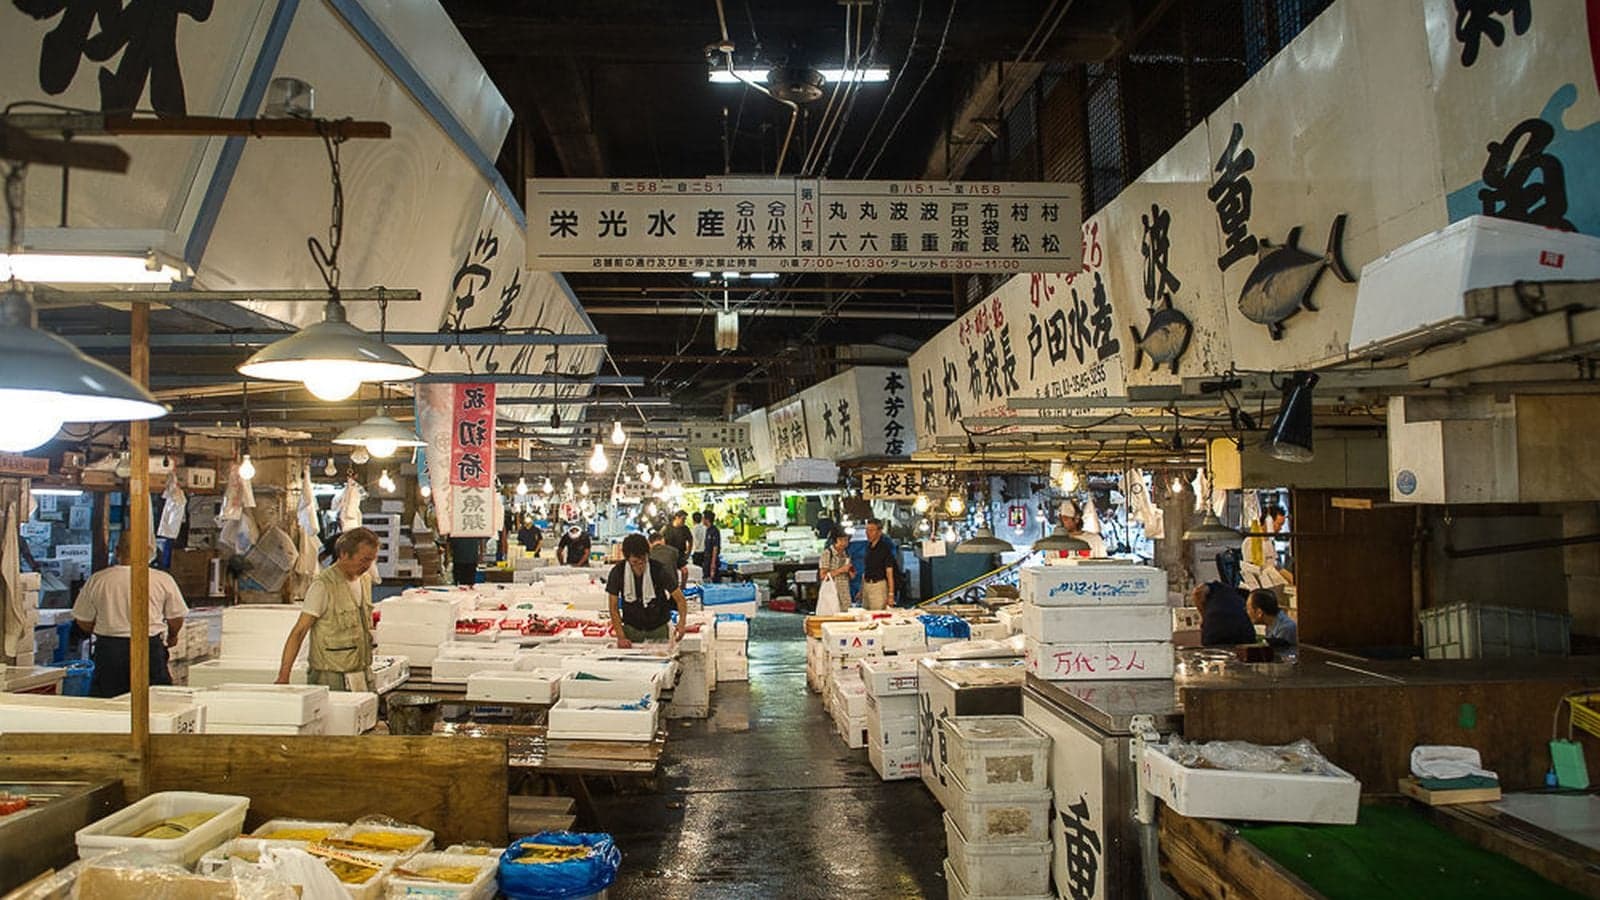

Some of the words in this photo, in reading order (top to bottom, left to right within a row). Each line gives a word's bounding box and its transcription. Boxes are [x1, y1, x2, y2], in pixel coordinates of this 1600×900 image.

[549, 208, 726, 239] 栄光水産
[800, 187, 814, 252] 第八十一棟
[827, 201, 848, 252] 丸六
[859, 201, 879, 252] 丸六
[889, 202, 909, 252] 波重
[920, 202, 940, 252] 波重
[950, 202, 970, 253] 戸田水産
[981, 202, 1000, 253] 布袋長
[1010, 202, 1030, 254] 村松
[1040, 202, 1061, 254] 村松
[1027, 271, 1120, 381] 戸田水産
[967, 322, 1020, 405] 布袋長
[883, 371, 905, 456] 本芳分店
[922, 356, 962, 435] 村松
[822, 398, 853, 447] 本芳
[864, 473, 922, 496] 布袋長
